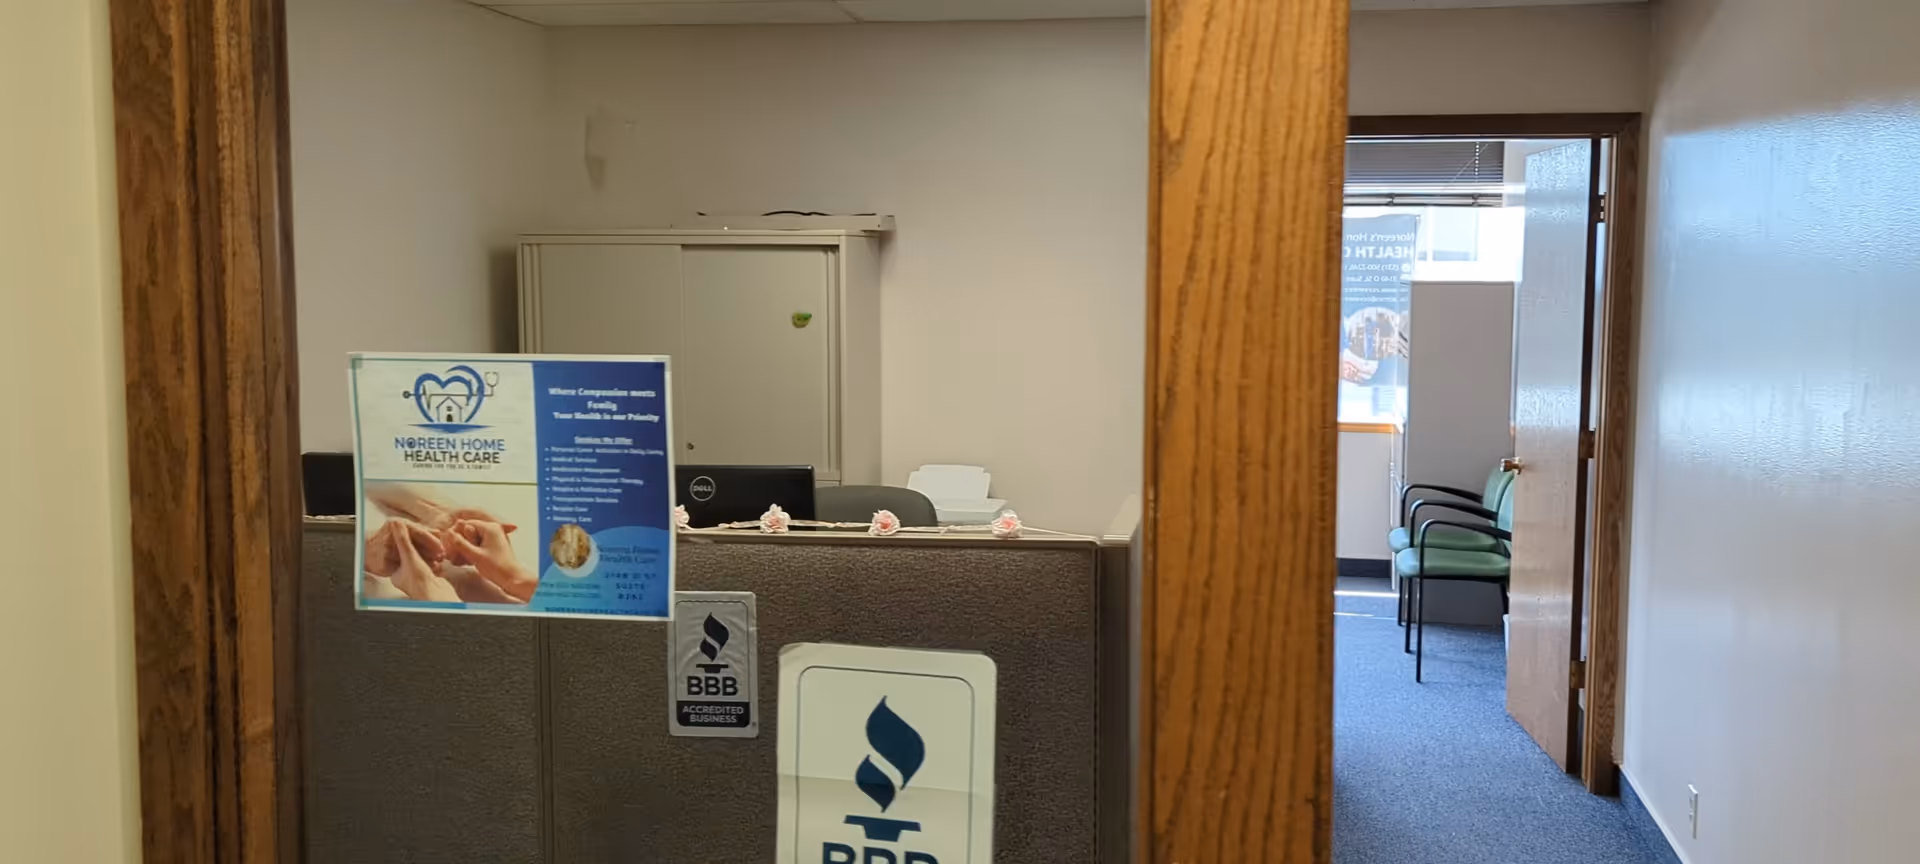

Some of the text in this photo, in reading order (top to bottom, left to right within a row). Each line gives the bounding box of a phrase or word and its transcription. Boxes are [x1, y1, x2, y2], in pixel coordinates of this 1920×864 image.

[394, 437, 505, 451] NOREEN HOME
[404, 450, 501, 463] HEALTH CARE
[687, 675, 738, 696] BBB
[682, 705, 744, 714] ACCREDITED
[689, 714, 737, 723] BUSINESS
